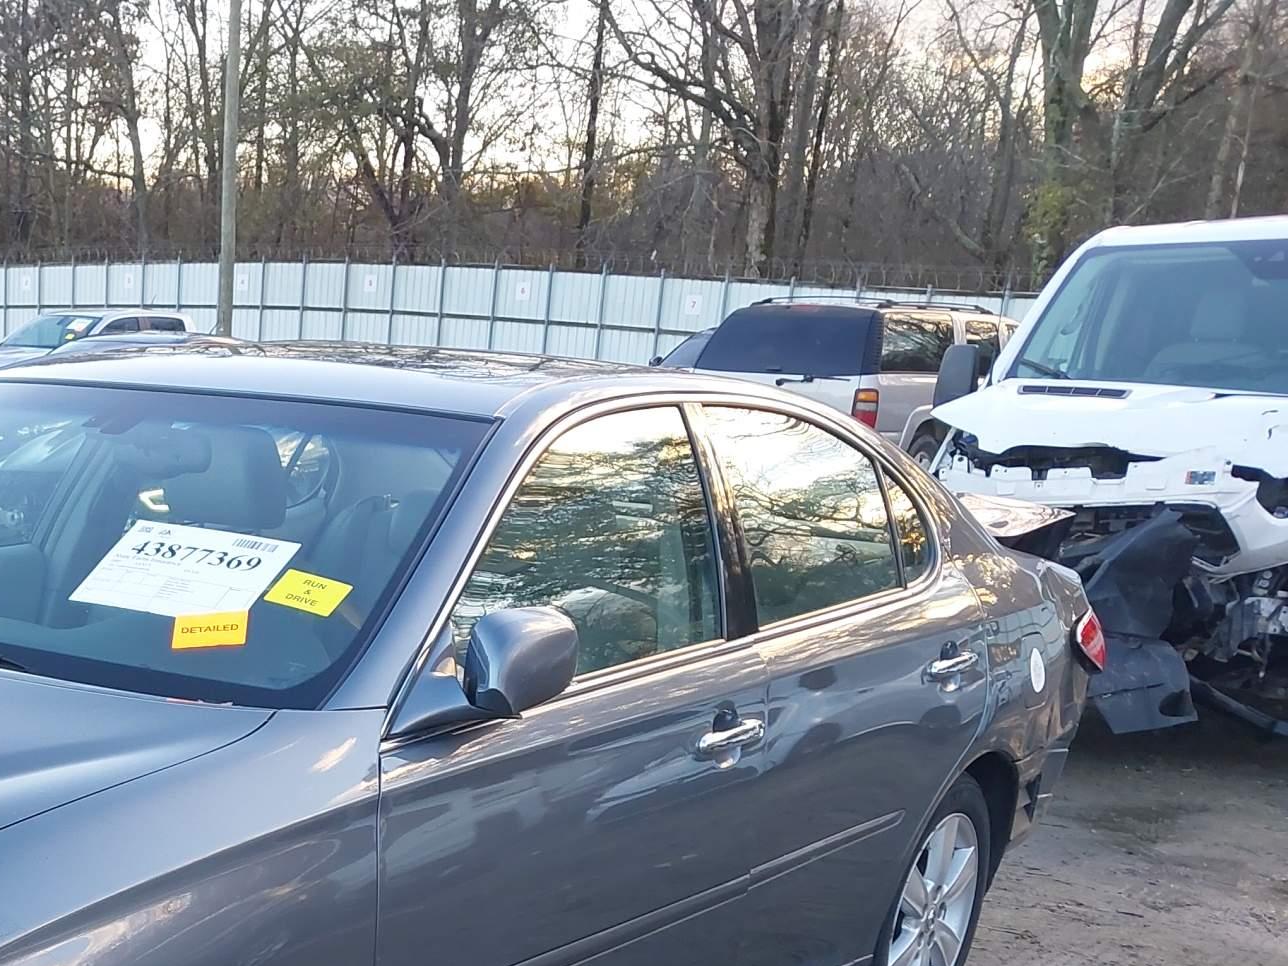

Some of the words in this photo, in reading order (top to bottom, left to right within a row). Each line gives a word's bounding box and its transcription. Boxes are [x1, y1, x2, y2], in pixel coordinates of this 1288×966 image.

[131, 540, 262, 572] 43877369
[302, 579, 327, 590] RUN
[285, 592, 318, 607] DRIVE
[180, 623, 239, 635] DETAILED
